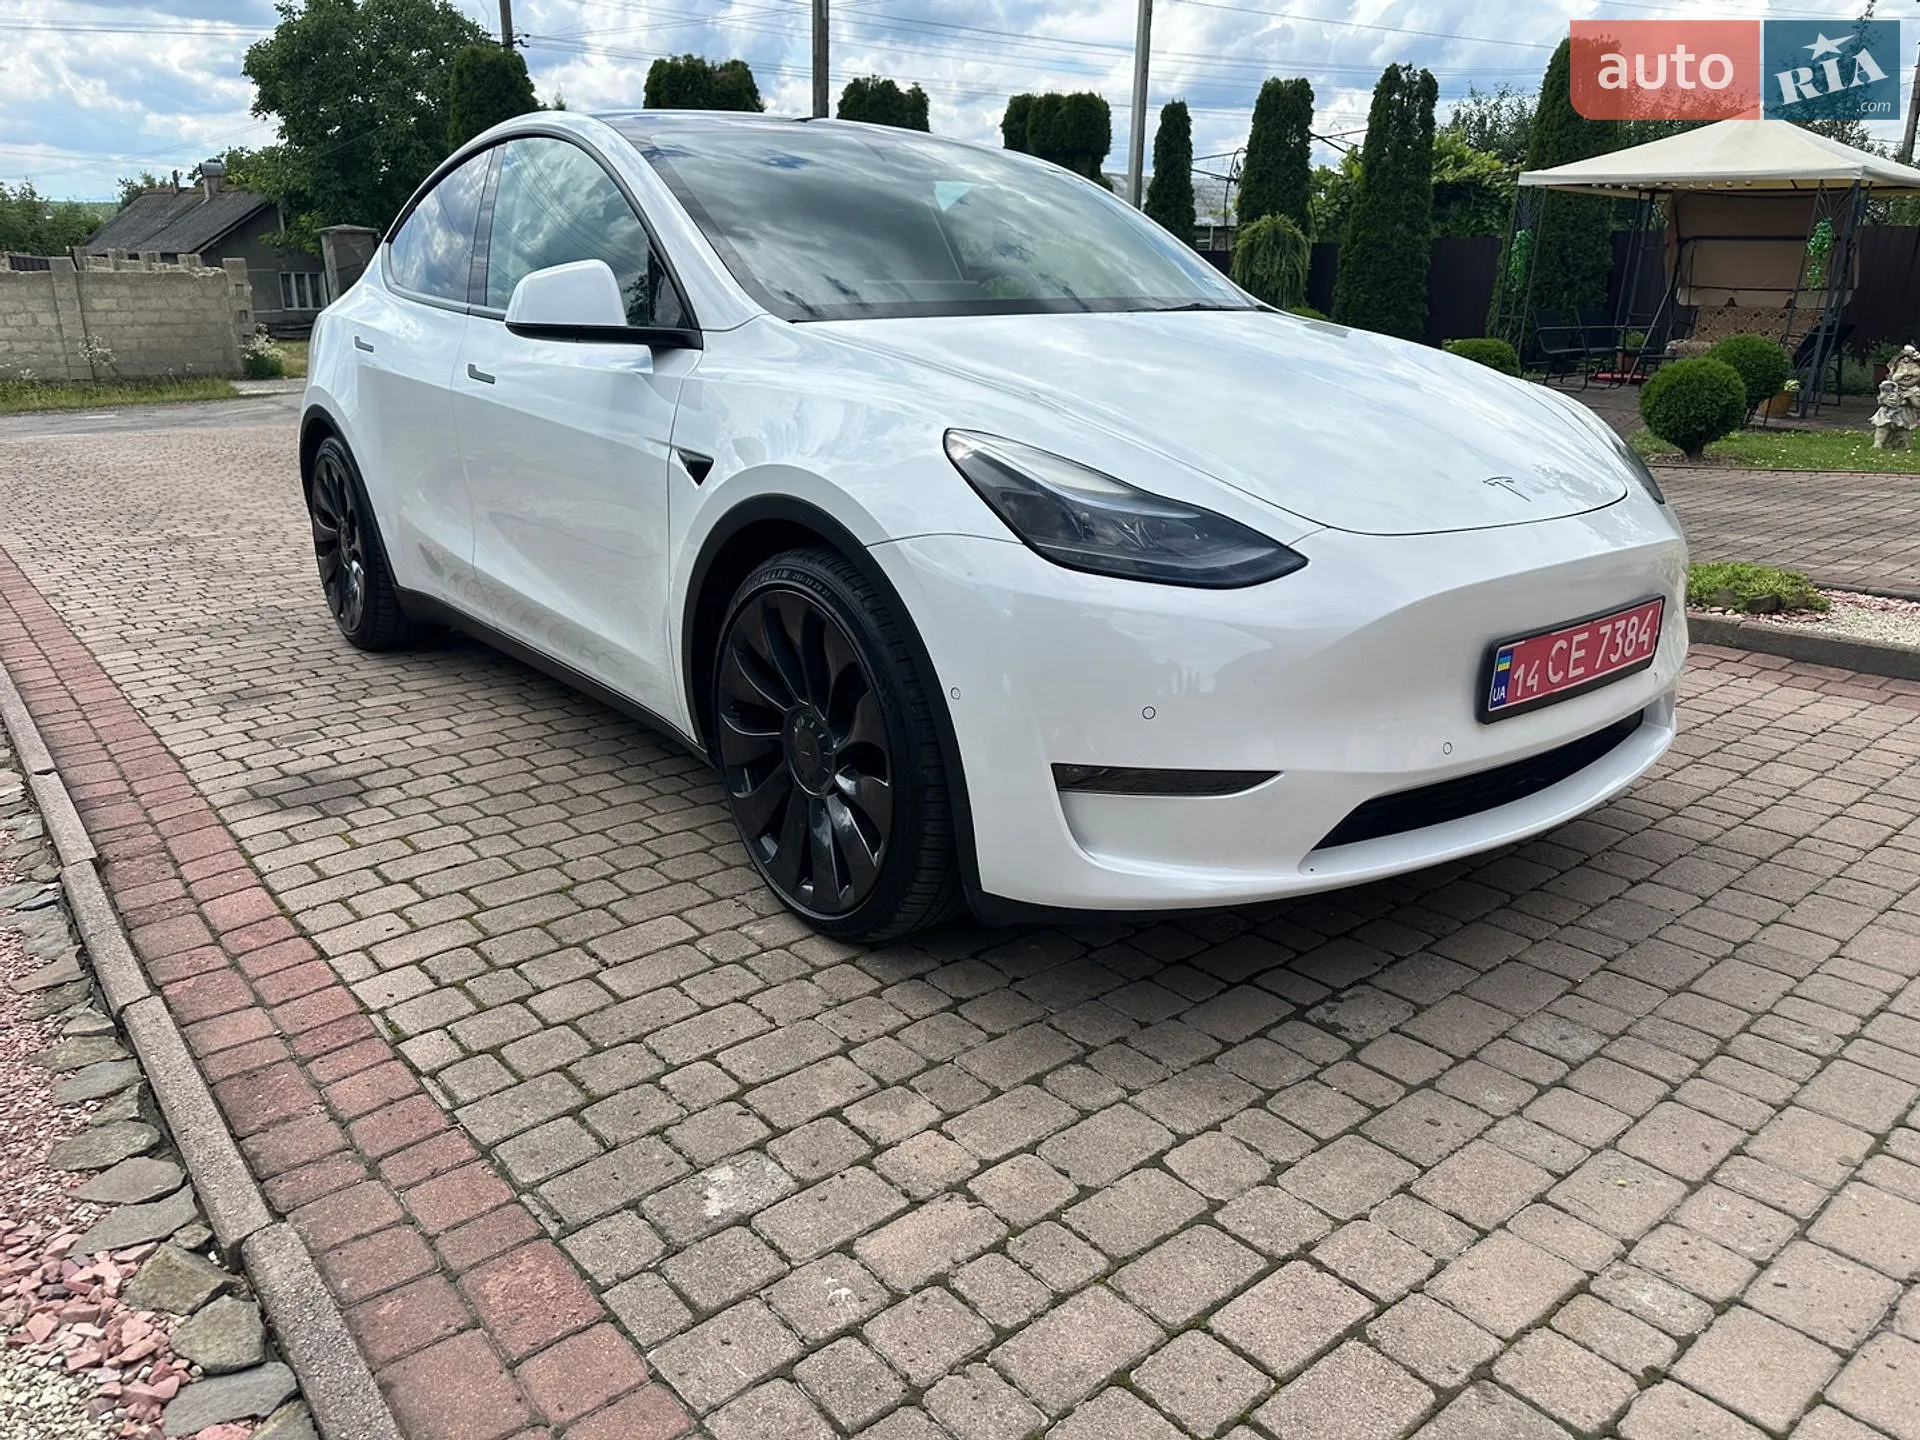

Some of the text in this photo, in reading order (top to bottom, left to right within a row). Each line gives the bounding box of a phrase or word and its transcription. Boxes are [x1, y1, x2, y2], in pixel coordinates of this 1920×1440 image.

[1513, 610, 1654, 697] 14 CE 7384
[1492, 685, 1506, 702] UA
